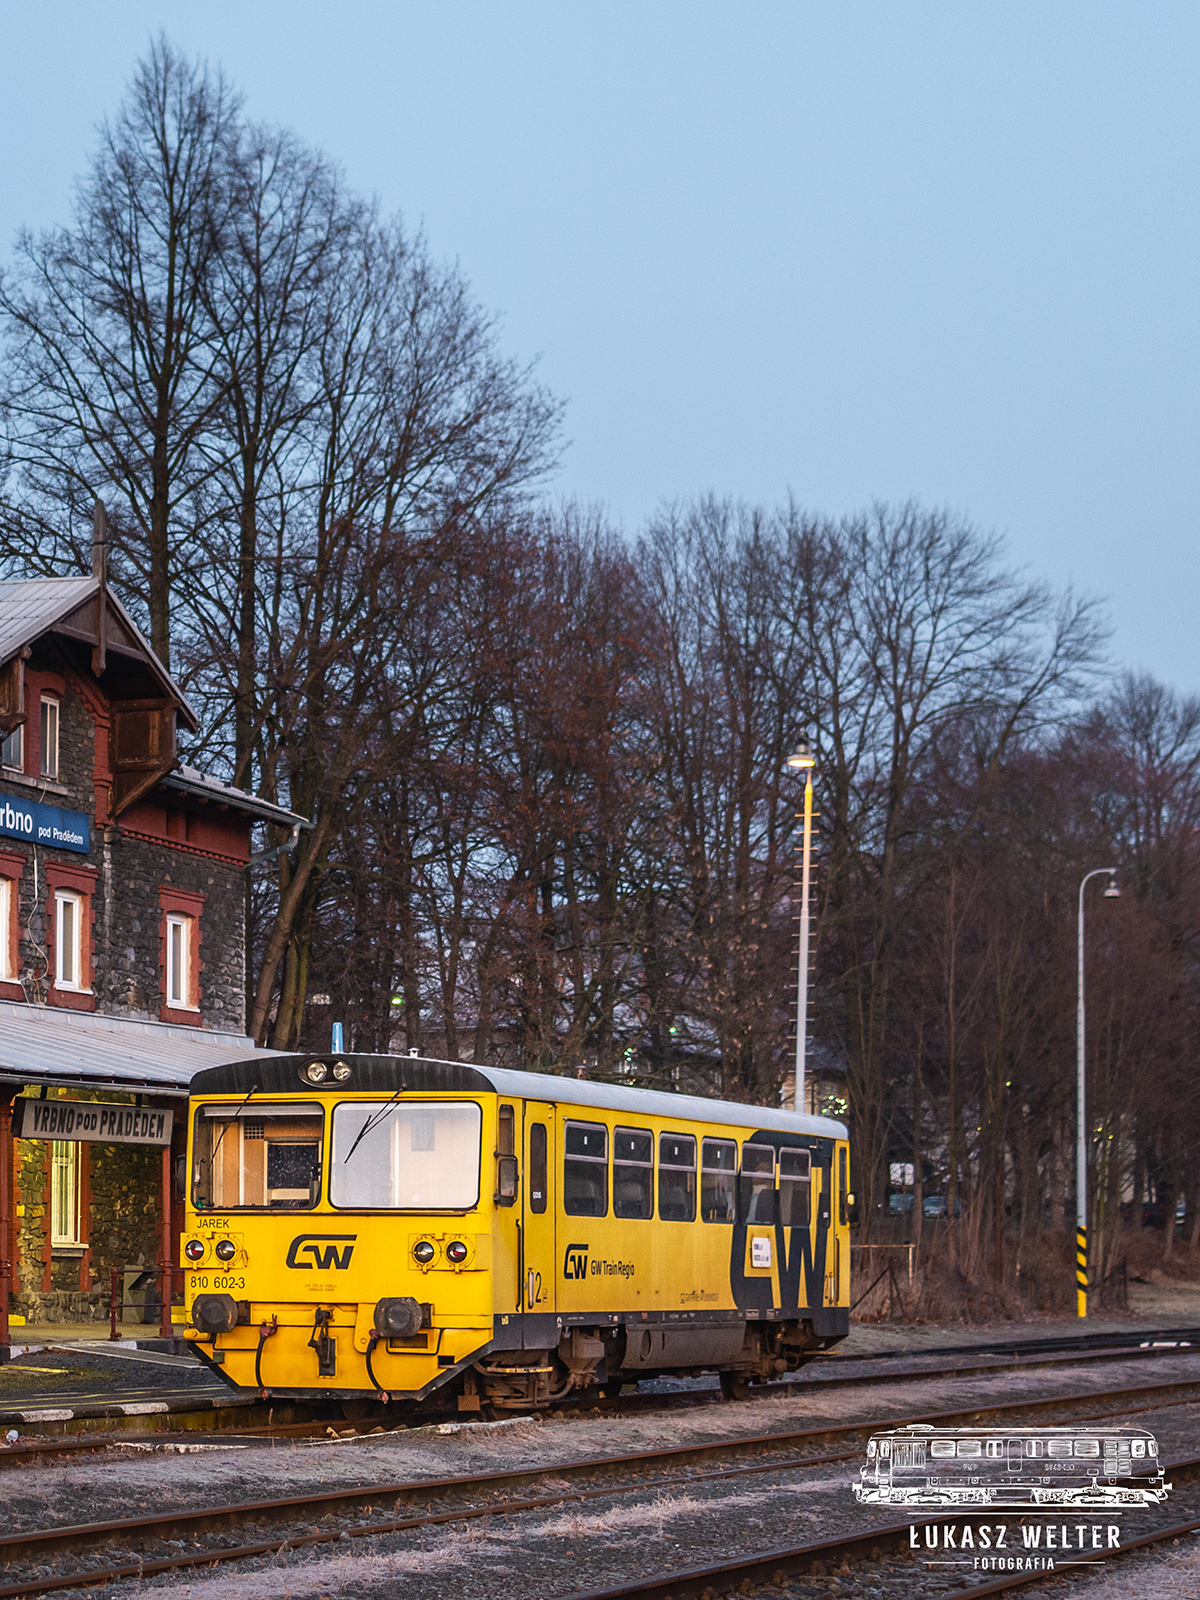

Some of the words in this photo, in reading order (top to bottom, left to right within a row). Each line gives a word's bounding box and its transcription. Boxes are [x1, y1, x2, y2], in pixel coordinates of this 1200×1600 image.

[38, 826, 51, 839] pod
[53, 827, 84, 845] Pradědem
[34, 1105, 75, 1134] VRBNO
[76, 1112, 98, 1131] POD
[99, 1109, 165, 1138] PRADĚDEM
[196, 1218, 230, 1229] JAREK
[590, 1260, 602, 1276] GW
[603, 1260, 618, 1276] Train
[618, 1260, 635, 1279] Regio
[190, 1276, 209, 1289] 810
[213, 1276, 246, 1289] 602-3
[535, 1271, 542, 1303] 2
